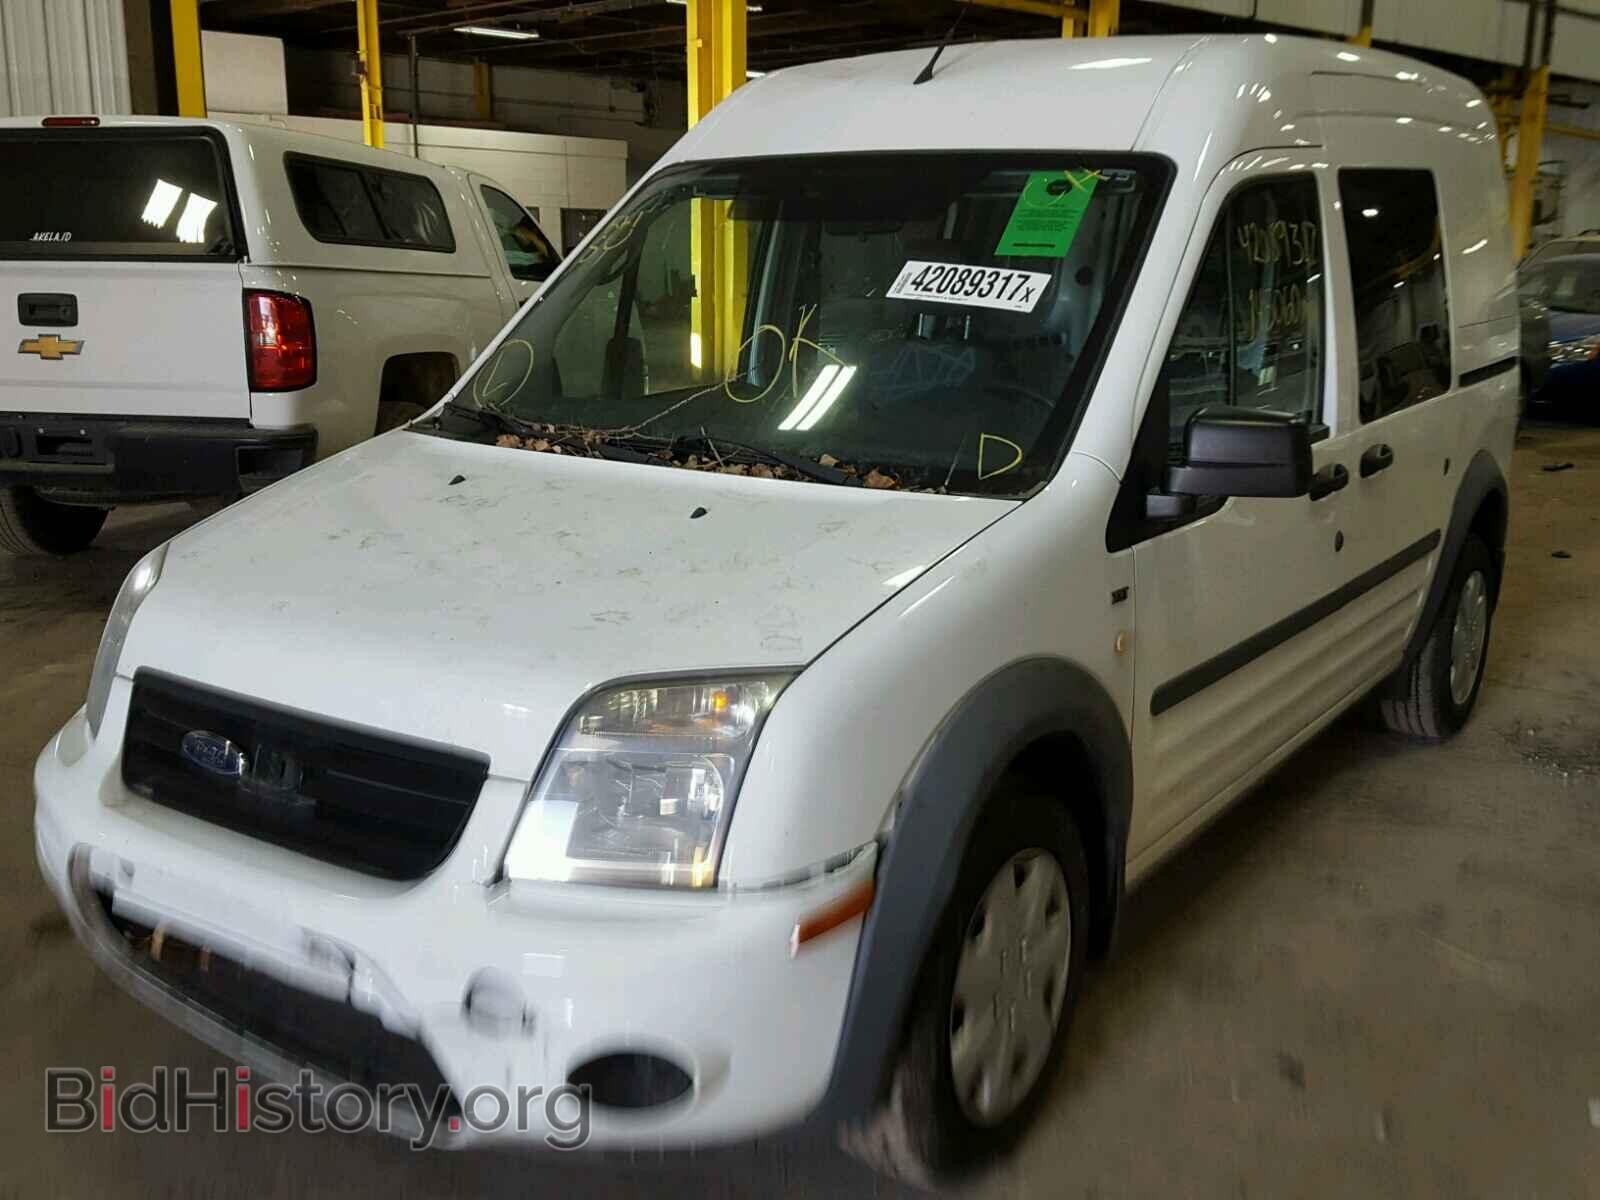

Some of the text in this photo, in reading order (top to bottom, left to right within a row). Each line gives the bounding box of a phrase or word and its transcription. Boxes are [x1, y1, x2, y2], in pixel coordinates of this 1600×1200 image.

[910, 264, 1032, 302] 42089317
[724, 303, 847, 403] OK
[978, 432, 1022, 480] D
